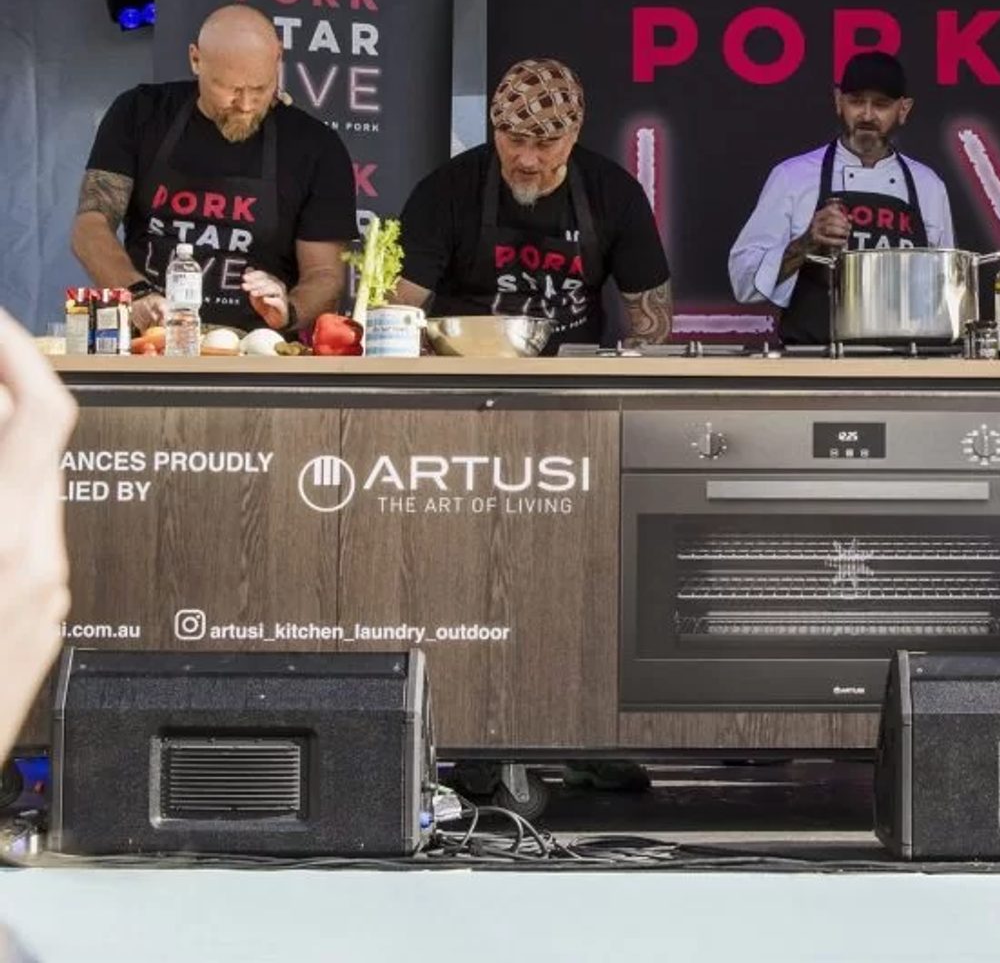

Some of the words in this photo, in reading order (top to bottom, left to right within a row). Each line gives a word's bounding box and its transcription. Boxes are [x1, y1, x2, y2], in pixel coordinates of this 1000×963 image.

[273, 16, 379, 56] TAR
[277, 62, 380, 112] IVE
[840, 204, 914, 234] ORK
[853, 231, 915, 250] TAR
[60, 450, 147, 472] ANCES
[153, 451, 274, 473] PROUDLY
[362, 454, 590, 492] ARTUSI
[117, 480, 151, 502] BY
[378, 496, 416, 514] THE
[424, 496, 464, 514] ART
[471, 496, 497, 514] OF
[505, 496, 573, 515] LIVING
[210, 622, 510, 642] artusi_kitchen_laundry_outdoor
